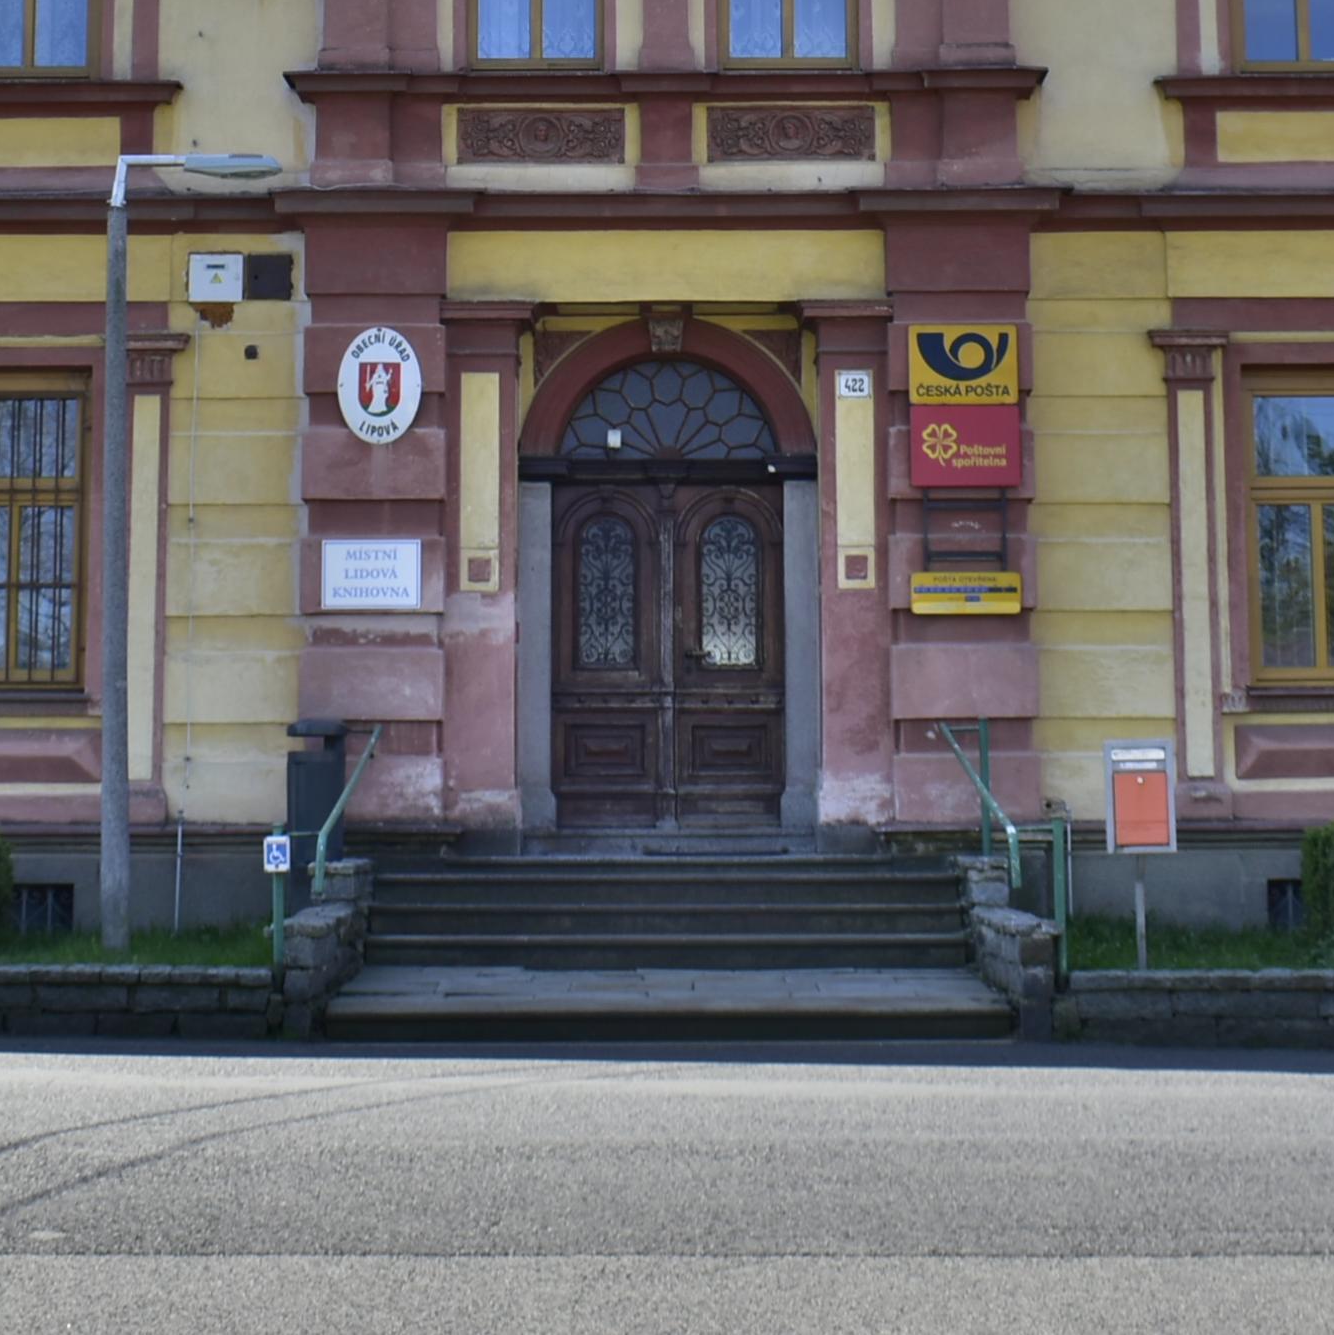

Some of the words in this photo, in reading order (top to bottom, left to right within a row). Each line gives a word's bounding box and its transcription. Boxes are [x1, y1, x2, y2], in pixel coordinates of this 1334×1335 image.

[351, 331, 386, 359] OBECNÍ
[388, 335, 411, 362] ÚŘAD
[844, 378, 865, 393] 422
[916, 383, 962, 397] ČESKÁ
[965, 383, 1010, 397] POŠTA
[359, 419, 399, 437] LIPOVÁ
[960, 444, 1006, 455] Poštovní
[952, 456, 1007, 468] spořitelna
[345, 547, 398, 560] MÍSTNÍ
[344, 565, 399, 579] LIDOVÁ
[332, 587, 410, 598] KNIHOVNA
